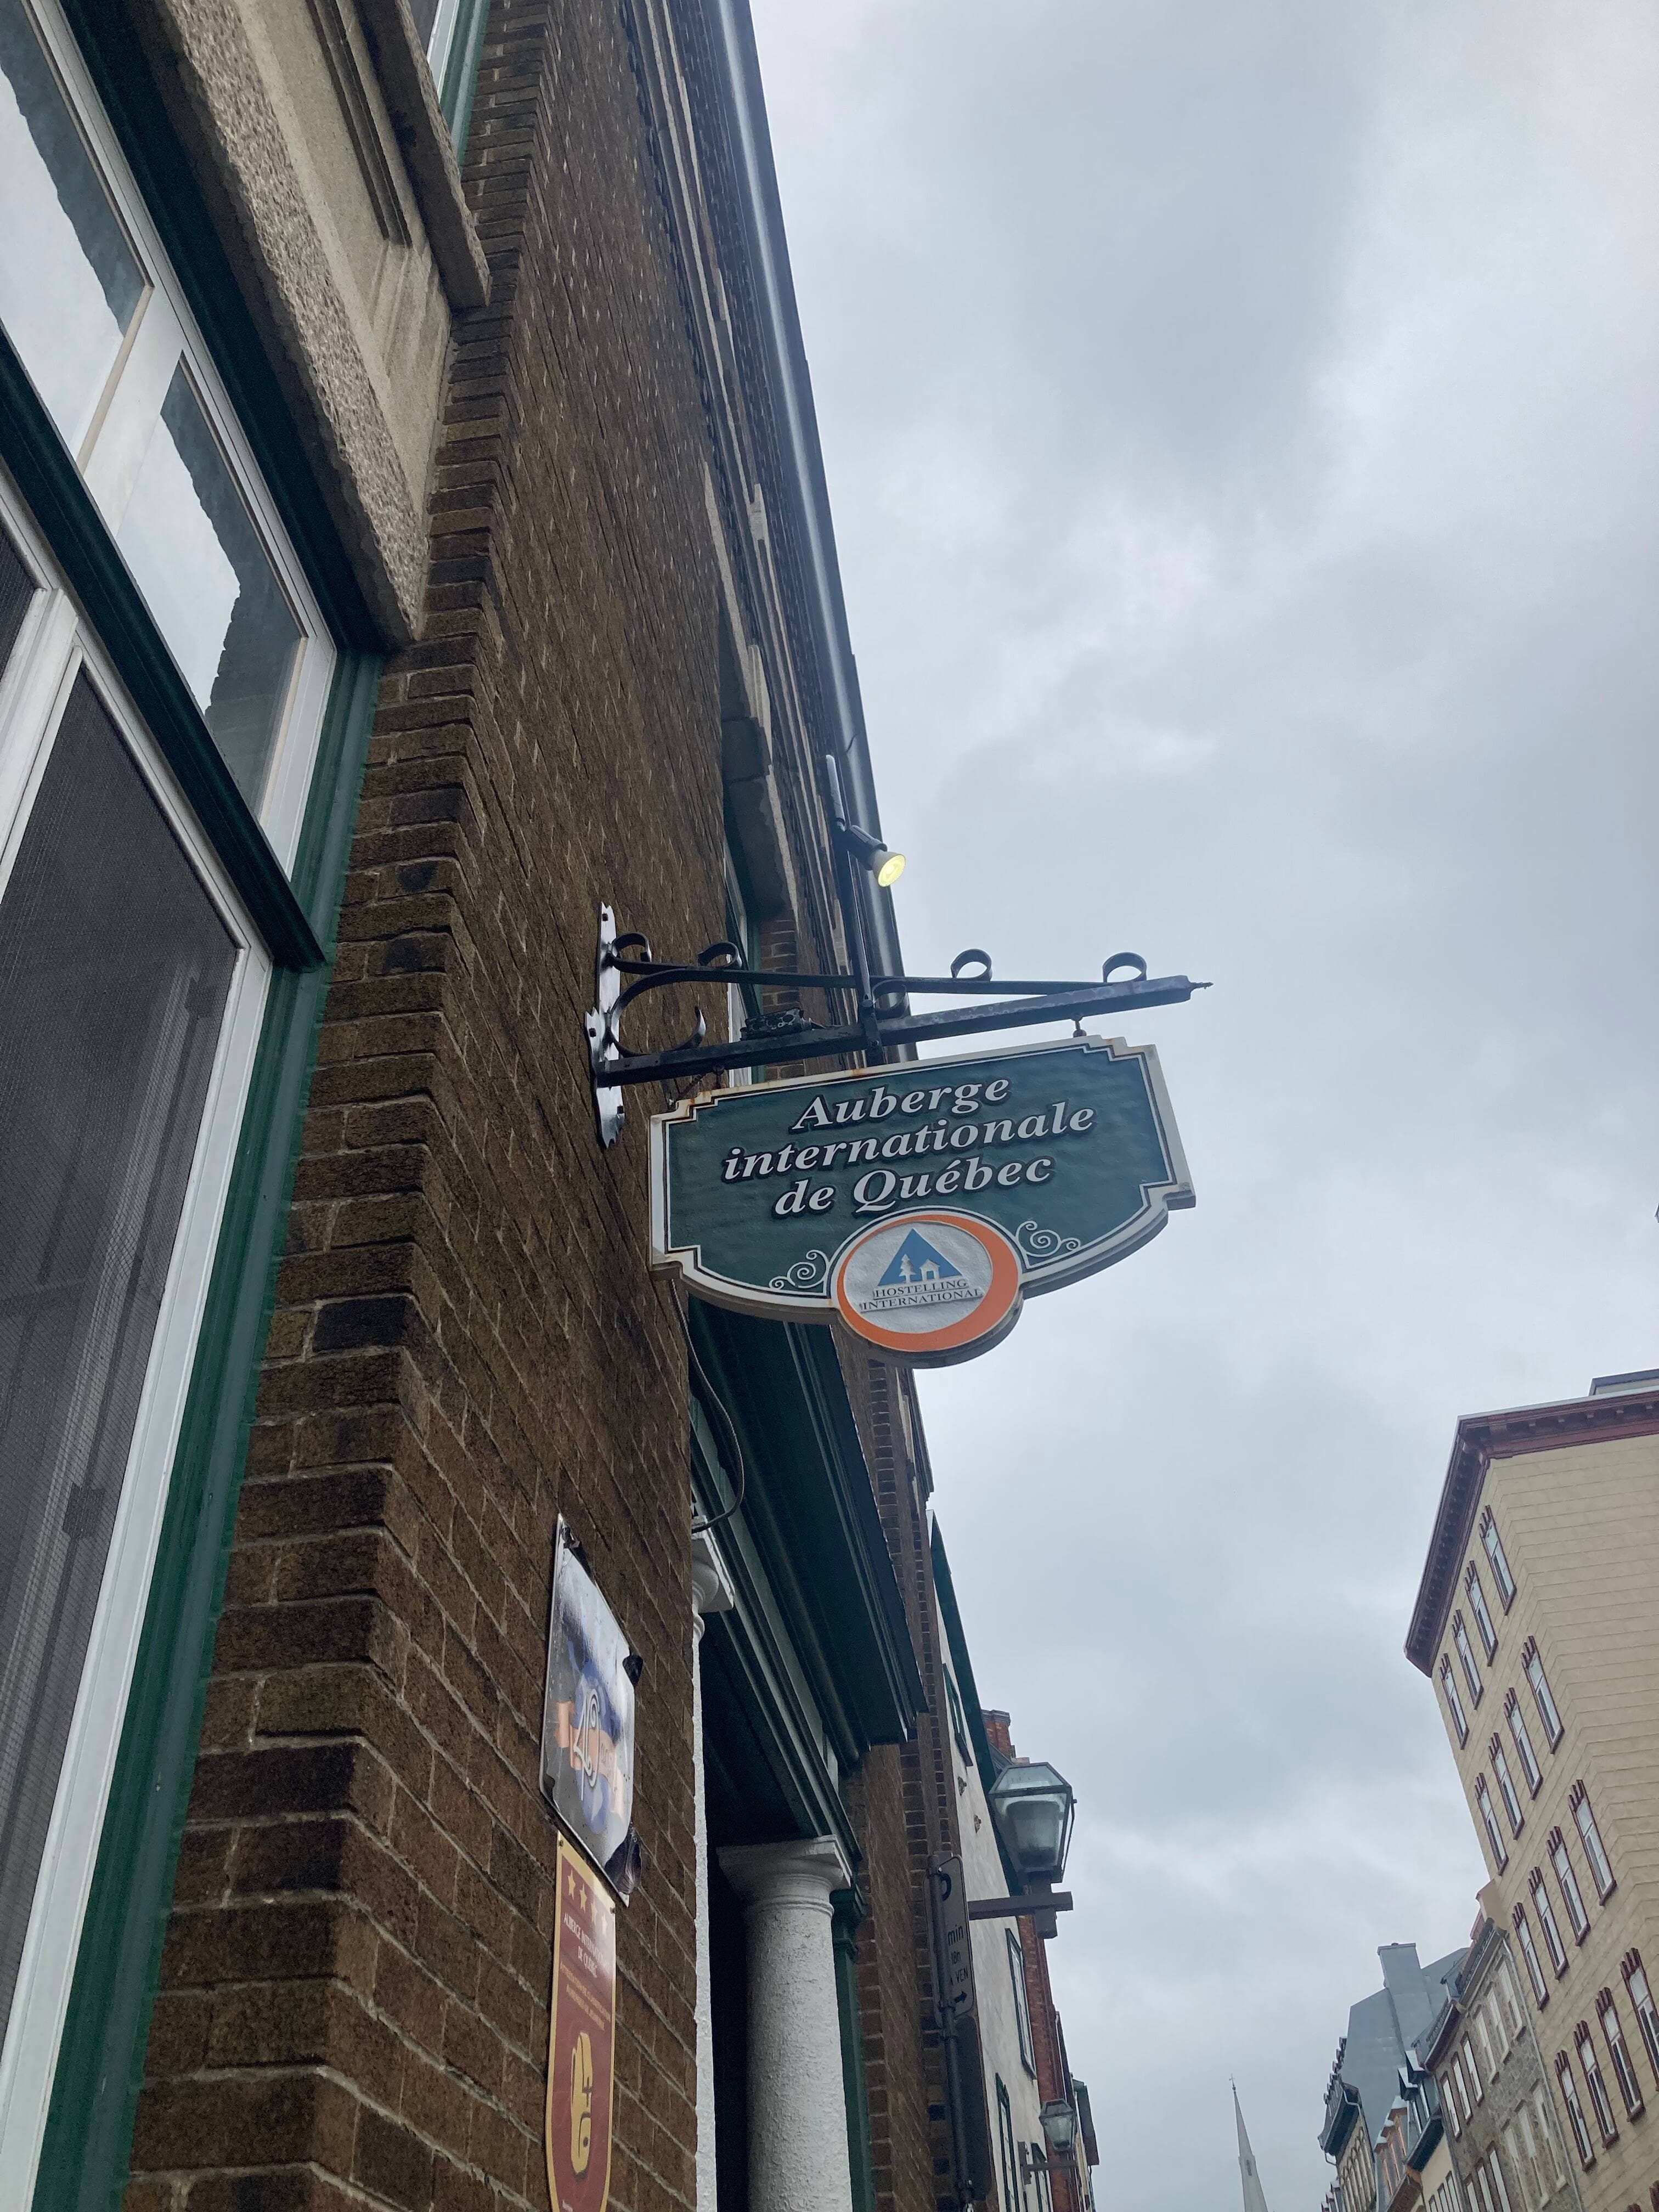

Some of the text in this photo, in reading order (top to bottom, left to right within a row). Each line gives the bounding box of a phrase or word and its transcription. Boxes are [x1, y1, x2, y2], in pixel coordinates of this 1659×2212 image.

[792, 1079, 1009, 1129] Auberge
[725, 1102, 1094, 1180] internationale
[775, 1158, 1052, 1215] de Québec
[864, 1289, 982, 1310] INTERNATIONAL
[876, 1279, 967, 1297] HOSTELLING
[956, 1966, 968, 1983] VEN
